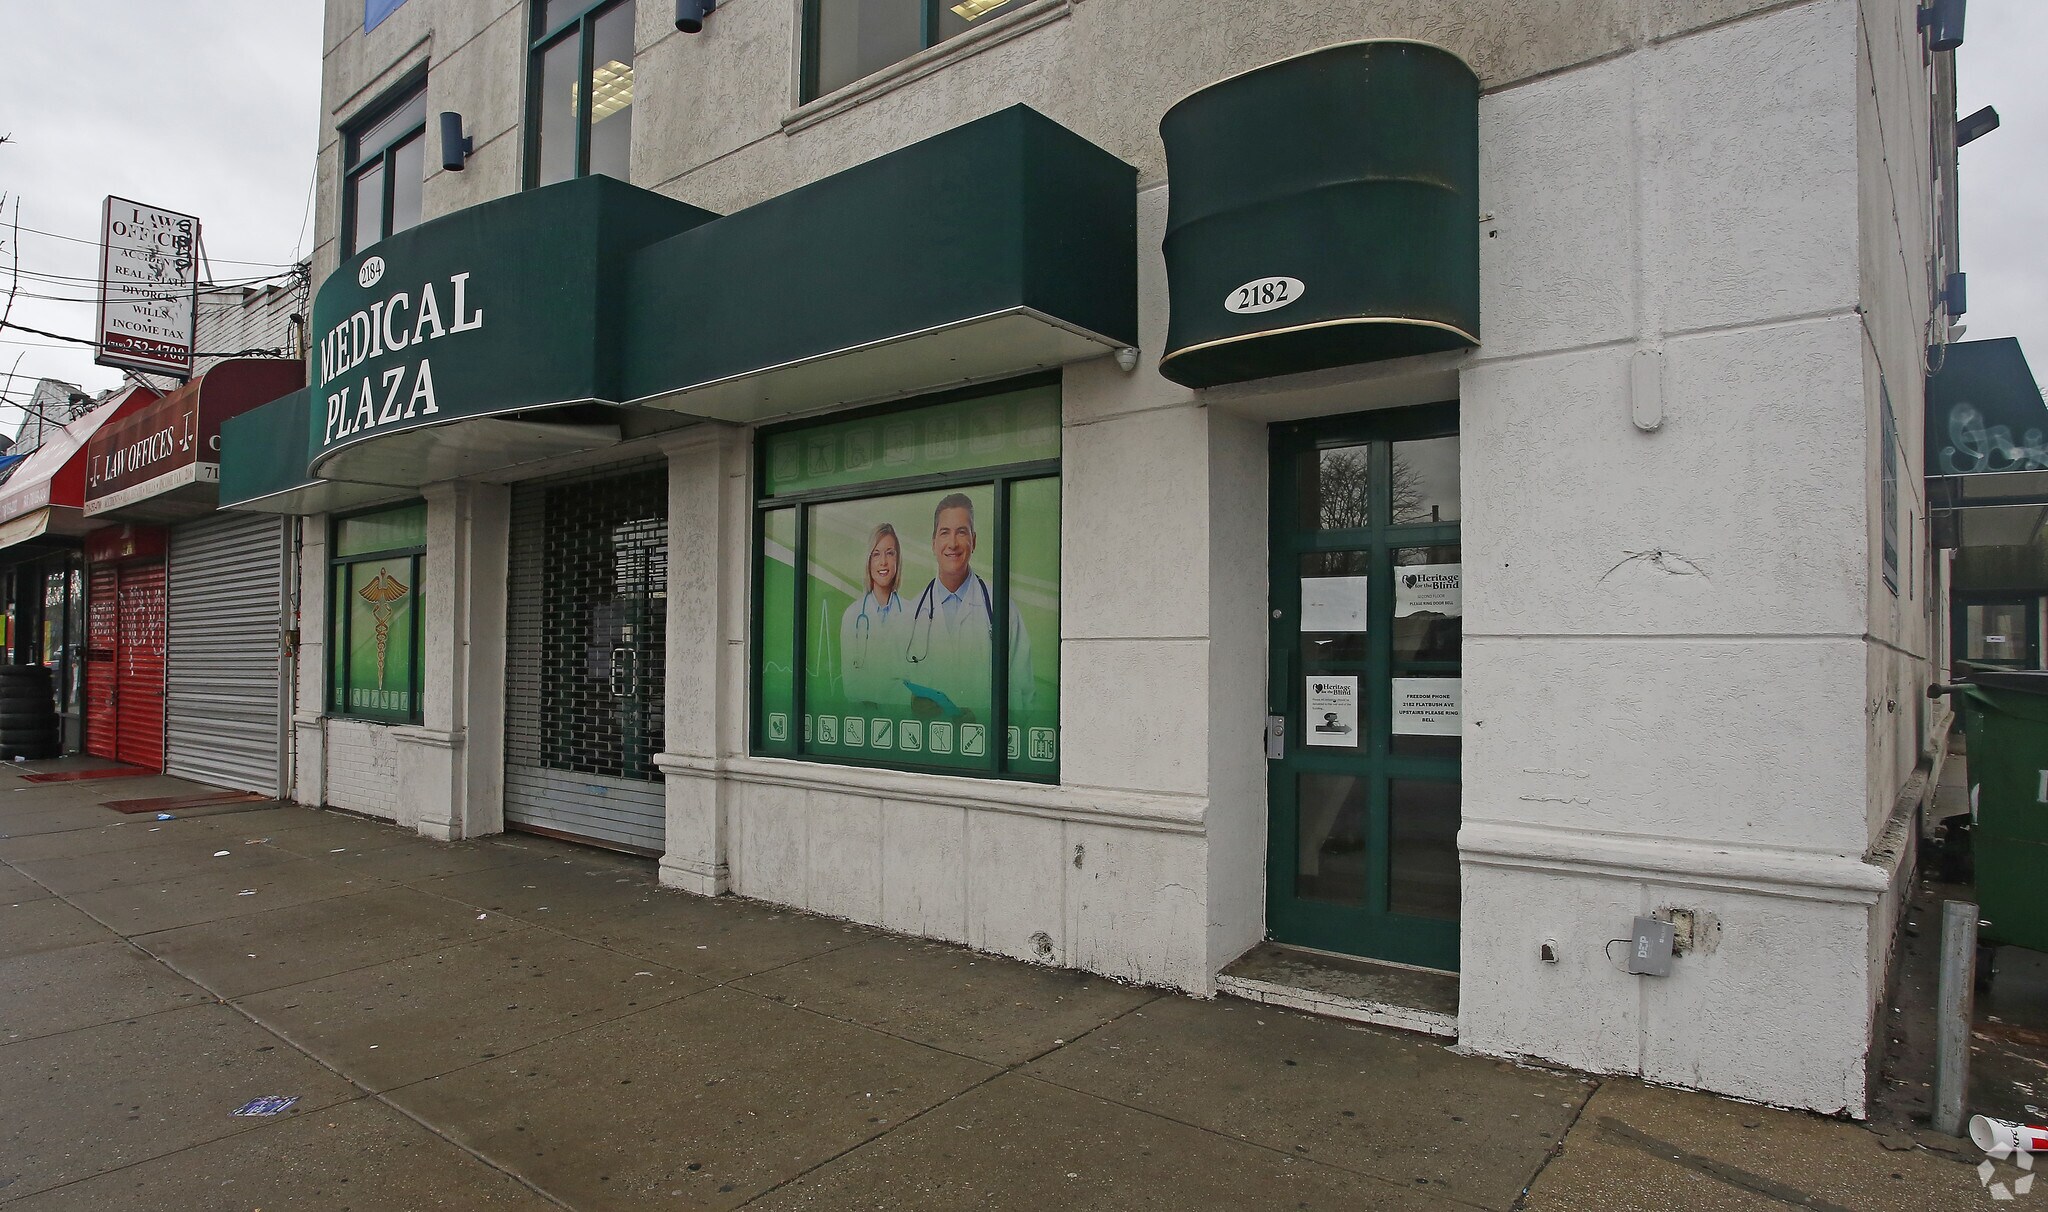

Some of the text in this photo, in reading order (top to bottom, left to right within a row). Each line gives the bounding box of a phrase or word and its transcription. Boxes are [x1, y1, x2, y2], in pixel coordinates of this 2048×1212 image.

[132, 208, 177, 229] LAW
[115, 265, 145, 280] REAL
[361, 259, 382, 284] 2184
[122, 284, 178, 304] DIVORCES
[1237, 280, 1289, 310] 2182
[132, 304, 169, 319] WILLS
[113, 318, 184, 340] INCOME TAX
[320, 271, 483, 389] MEDICAL
[323, 358, 439, 446] PLAZA
[104, 425, 175, 482] LAW OFFICES
[1417, 573, 1459, 584] Heritage
[1432, 581, 1459, 590] Blind
[1323, 683, 1351, 691] Heritage
[1637, 935, 1649, 959] DEP
[2010, 1128, 2020, 1148] KFC
